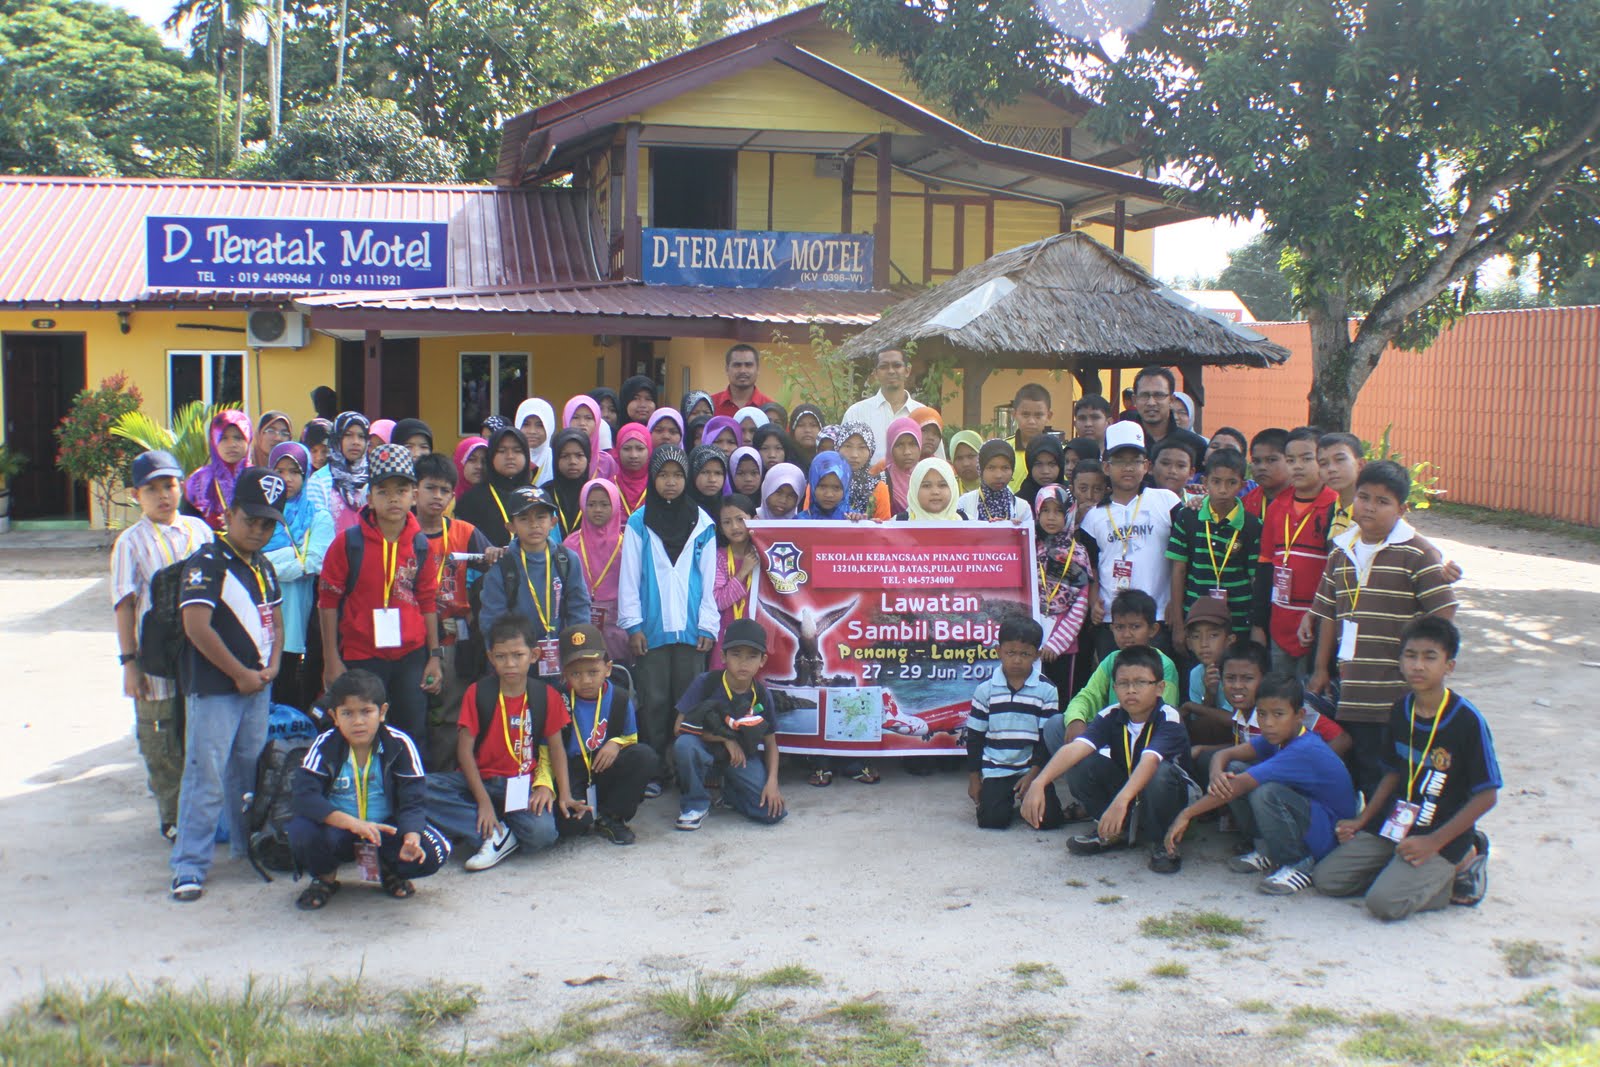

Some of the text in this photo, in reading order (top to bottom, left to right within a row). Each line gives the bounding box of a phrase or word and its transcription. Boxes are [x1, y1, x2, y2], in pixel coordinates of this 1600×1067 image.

[206, 224, 326, 266] Teratak
[341, 229, 432, 268] Motel
[653, 236, 863, 273] D-TERATAK MOTEL
[197, 271, 216, 283] TEL
[238, 272, 260, 283] 019
[263, 273, 311, 284] 4499464
[330, 273, 351, 285] 019
[355, 274, 400, 286] 4111921
[815, 553, 1019, 561] SEKOLAH KEBANGSAAN PINANG TUNGGAL
[832, 564, 1003, 574] 13210,KEPALA BATAS,PULAU PINANG
[882, 576, 900, 584] TEL
[908, 576, 954, 584] 04-5734000
[881, 592, 978, 612] Lawatan
[847, 620, 927, 640] Sambil
[837, 643, 909, 664] Penang
[931, 644, 999, 664] Langka
[862, 664, 882, 679] 27
[899, 664, 922, 679] 29
[927, 664, 957, 679] Jun
